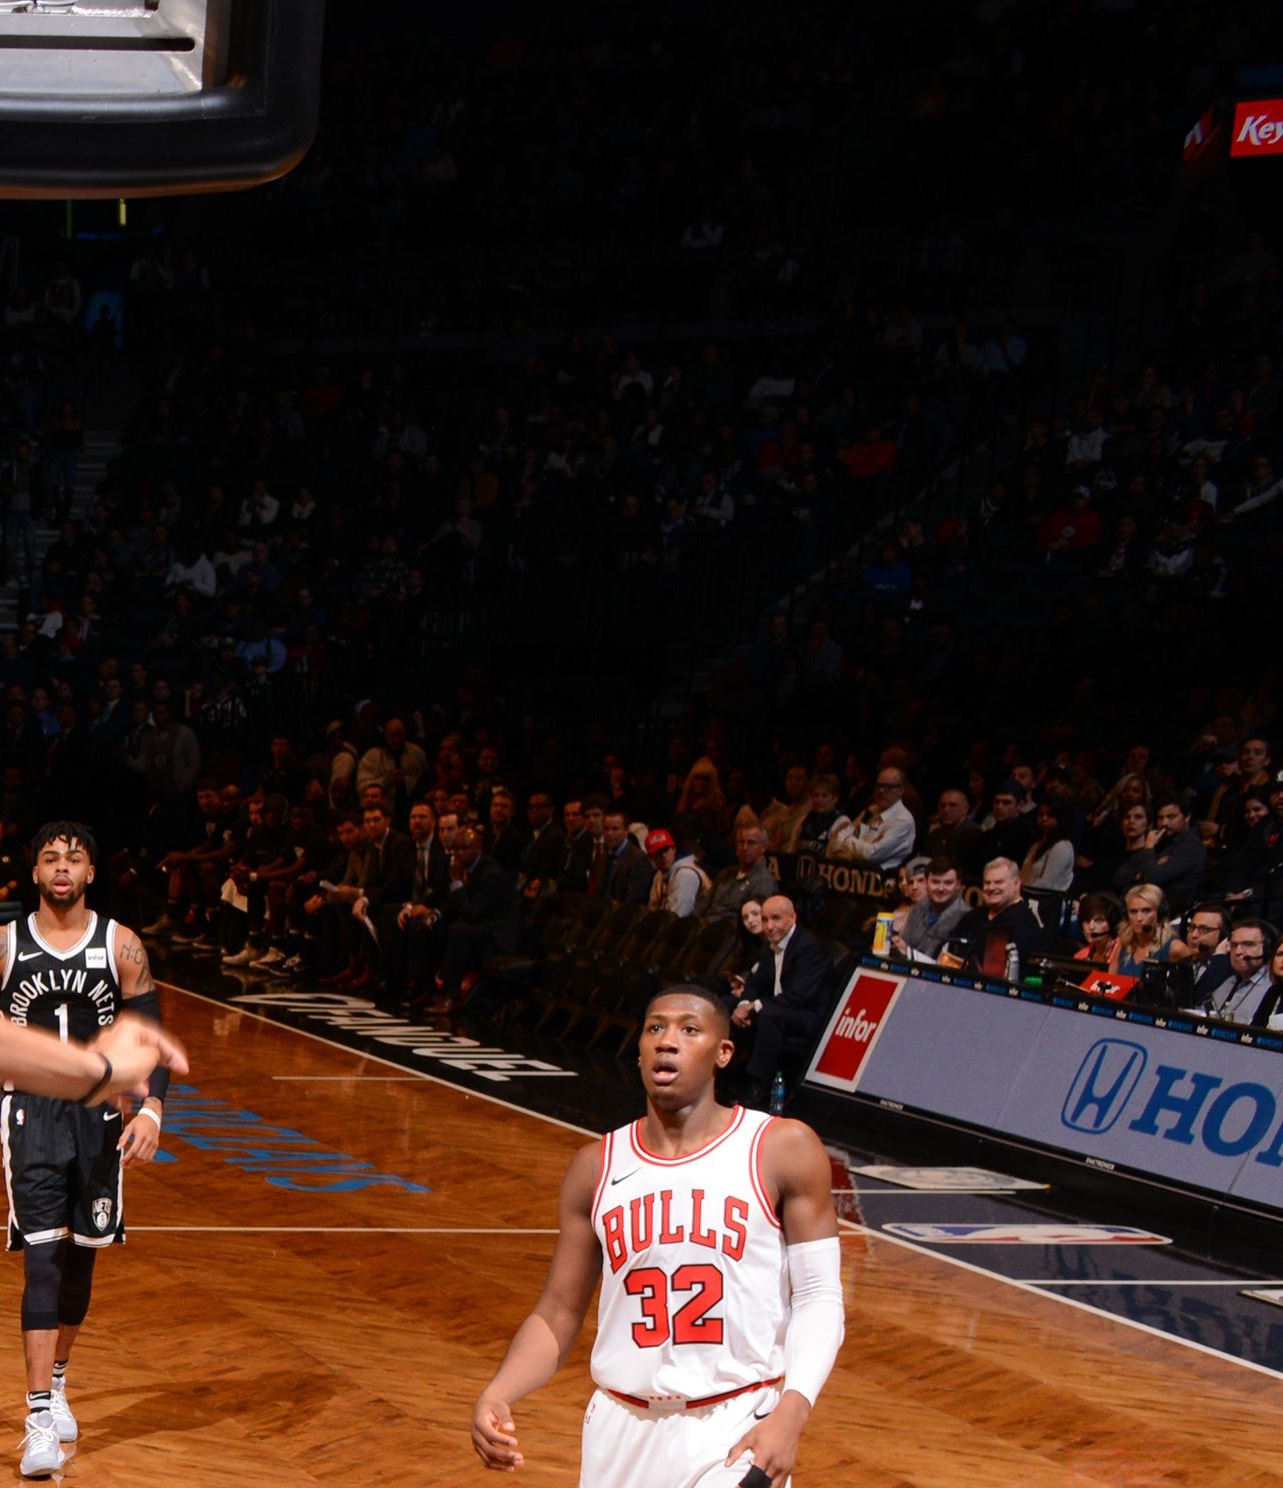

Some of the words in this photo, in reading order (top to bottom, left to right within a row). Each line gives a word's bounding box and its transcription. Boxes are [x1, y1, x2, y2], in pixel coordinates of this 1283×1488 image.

[9, 968, 88, 1028] BROOKLYN
[87, 979, 115, 1027] NETS
[53, 1003, 69, 1044] 1
[835, 1008, 878, 1044] infor
[601, 1188, 749, 1275] BULLS
[623, 1263, 724, 1349] 32
